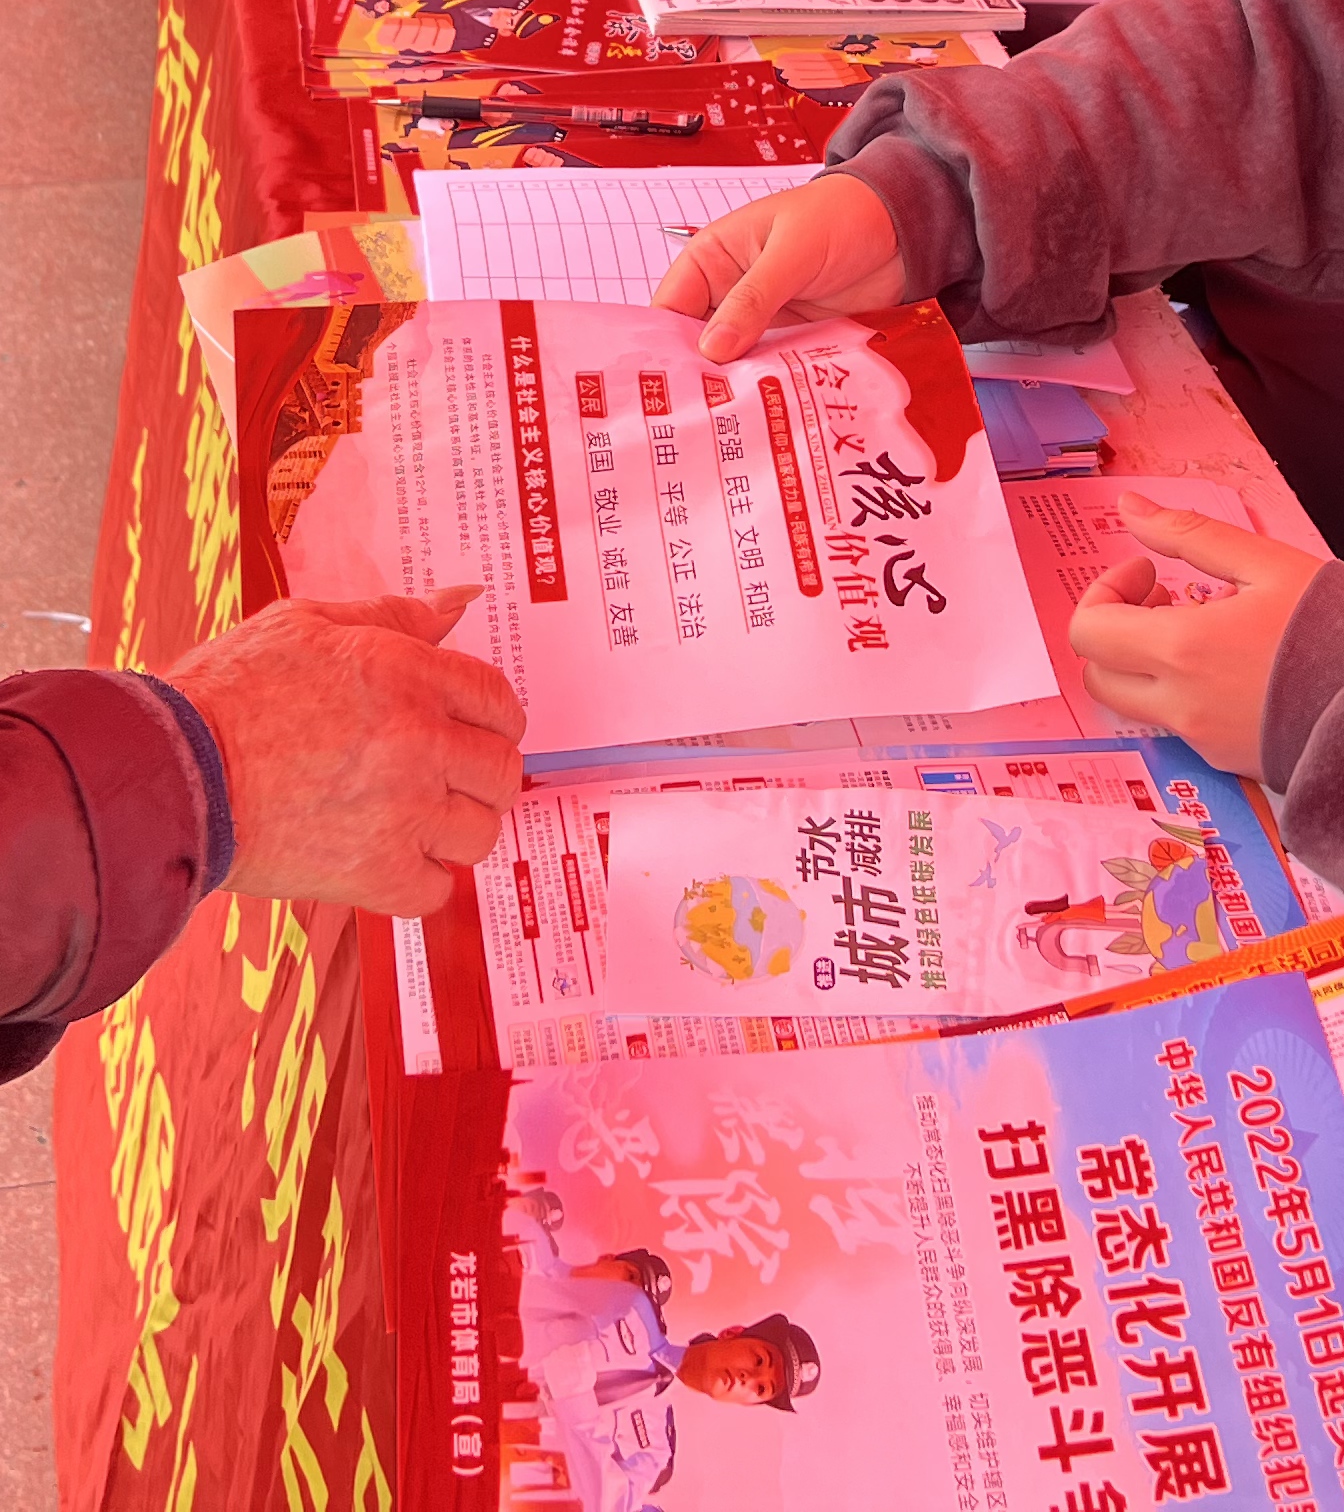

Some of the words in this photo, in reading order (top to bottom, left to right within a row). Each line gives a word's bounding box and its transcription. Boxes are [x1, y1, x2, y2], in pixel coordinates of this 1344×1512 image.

[579, 378, 602, 414] 公民
[641, 378, 667, 412] 社会
[586, 431, 615, 474] 爱国
[652, 423, 680, 466] 自由
[715, 414, 745, 463] 富强
[593, 487, 623, 535] 敬业
[659, 480, 689, 527] 平等
[724, 475, 754, 517] 民主
[601, 547, 630, 591] 诚信
[669, 538, 698, 582] 公正
[734, 526, 766, 570] 文明
[609, 602, 639, 648] 友善
[676, 592, 708, 642] 法治
[743, 581, 776, 628] 和谐
[796, 816, 842, 882] 节水
[843, 808, 883, 878] 减排
[908, 810, 948, 990] 推动绿色低碳发展
[832, 875, 912, 990] 城市
[1075, 1134, 1229, 1504] 常态化开展
[448, 1251, 485, 1480] 龙岩市体育局（宣）
